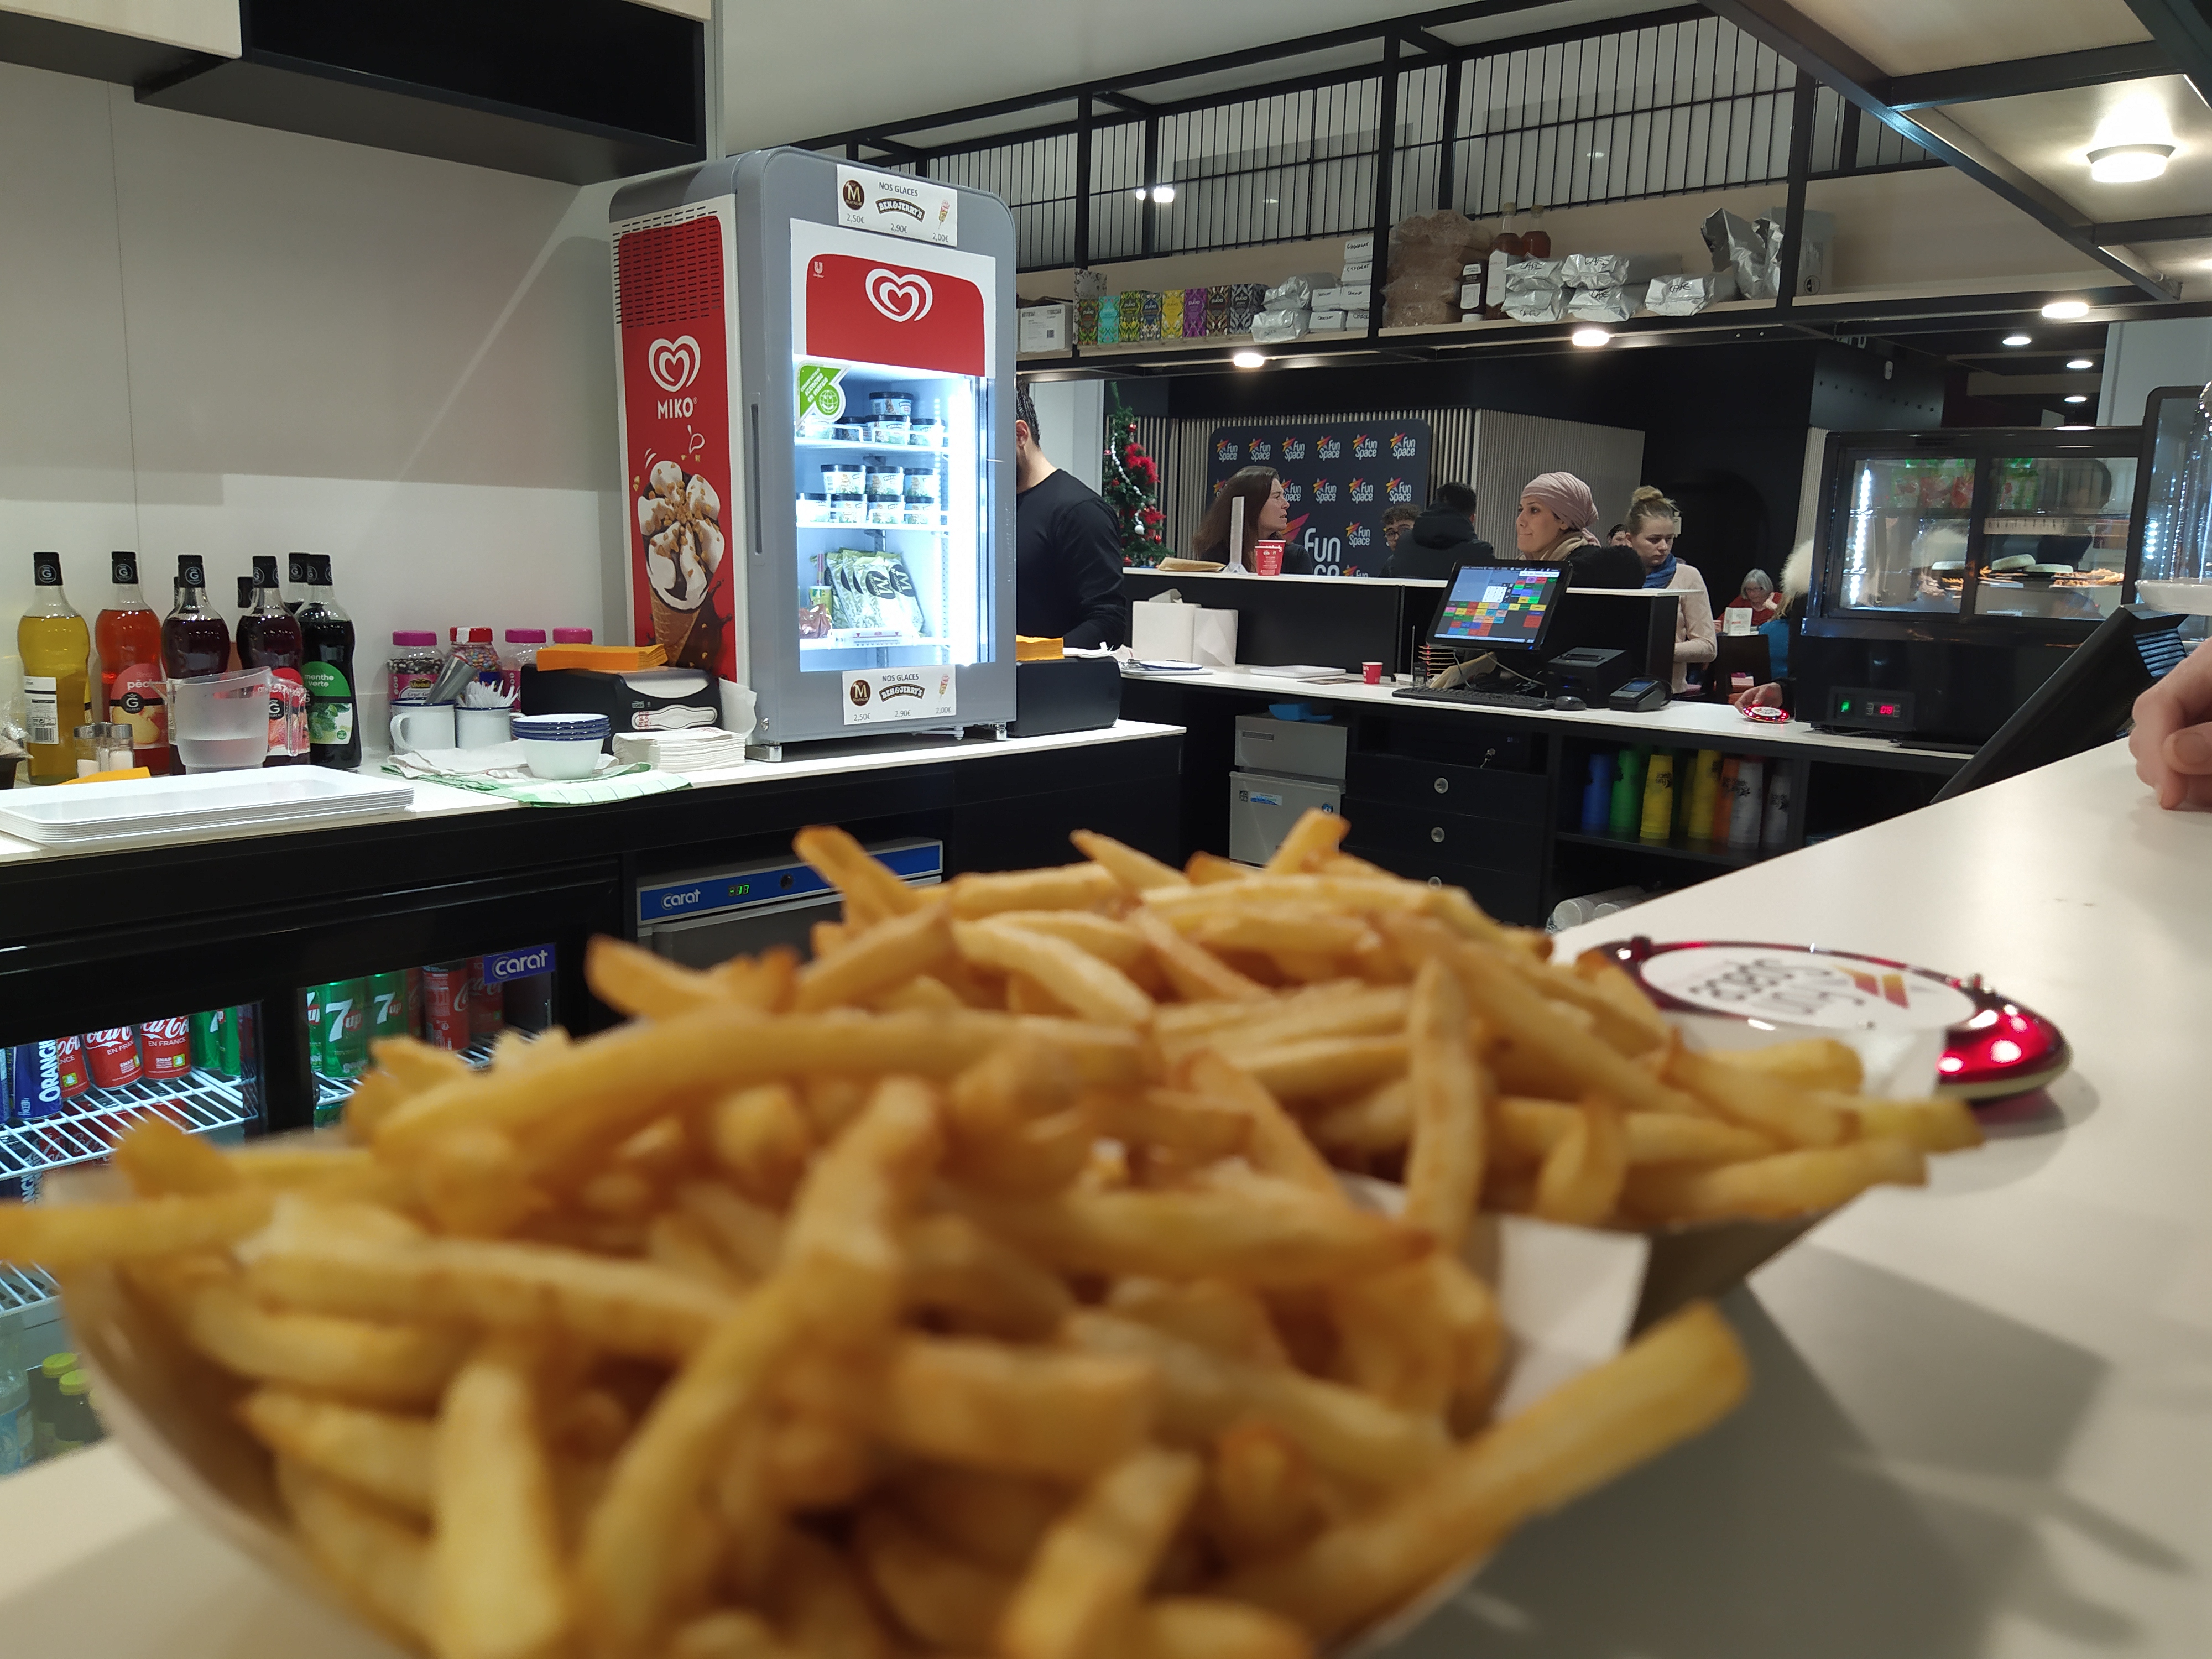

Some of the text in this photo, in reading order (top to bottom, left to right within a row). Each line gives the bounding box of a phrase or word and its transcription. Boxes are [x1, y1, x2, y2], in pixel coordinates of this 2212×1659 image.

[879, 181, 918, 197] NOS GLACES
[847, 213, 865, 224] 2,50€
[890, 223, 907, 233] 2,90€
[932, 232, 949, 243] 2,00€
[657, 397, 694, 420] MIKO
[1259, 442, 1271, 452] Fun
[1293, 441, 1305, 451] Fun
[1328, 440, 1340, 450] Fun
[1364, 438, 1378, 449] Fun
[1403, 436, 1416, 447] Fun
[1227, 442, 1238, 453] Fun
[1355, 446, 1377, 460] Space
[1392, 445, 1415, 460] Space
[1218, 450, 1237, 462] Space
[1250, 450, 1270, 462] Space
[1284, 448, 1305, 462] Space
[1319, 447, 1340, 461] Space
[1290, 483, 1302, 494] Fun
[1324, 482, 1337, 493] Fun
[1361, 482, 1374, 493] Fun
[1399, 482, 1412, 493] Fun
[1316, 490, 1337, 504] Space
[1352, 491, 1373, 504] Space
[1389, 491, 1411, 504] Space
[1358, 526, 1371, 538] Fun
[1348, 534, 1370, 548] Space
[936, 706, 952, 714] 2,00€
[854, 713, 871, 722] 2,50€
[662, 888, 701, 909] carat
[493, 949, 549, 977] carat
[159, 1036, 186, 1046] FRANCE
[119, 1058, 134, 1068] SNAP
